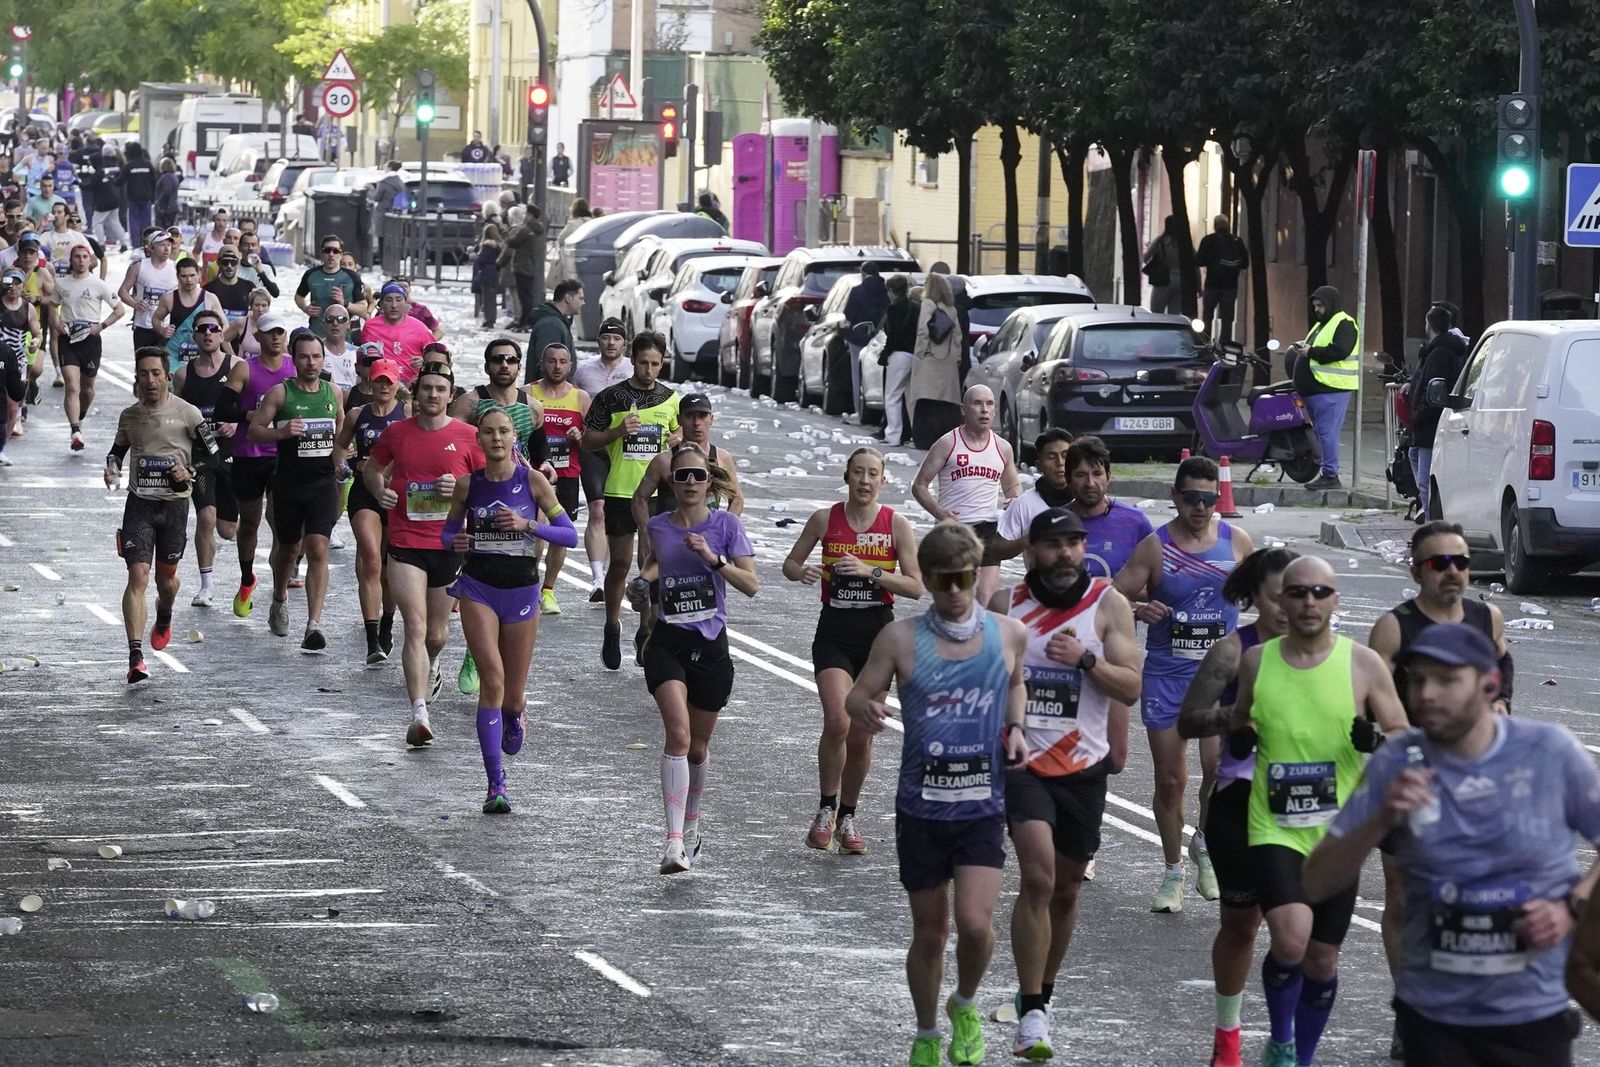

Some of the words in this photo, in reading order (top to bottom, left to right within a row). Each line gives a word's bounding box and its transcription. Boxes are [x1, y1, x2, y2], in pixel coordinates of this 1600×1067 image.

[330, 94, 350, 105] 30
[1122, 418, 1148, 429] 4249
[1151, 418, 1172, 429] GBR
[1275, 414, 1294, 422] cabify
[310, 423, 331, 433] ZURICH
[298, 441, 316, 450] JOSE
[317, 440, 334, 449] SILVA
[627, 443, 658, 452] MORENO
[474, 532, 524, 541] BERNADETTE
[856, 533, 892, 548] SOPH
[828, 543, 889, 557] SERPENTINE
[677, 575, 708, 585] ZURICH
[680, 590, 697, 599] 5263
[837, 589, 873, 600] SOPHIE
[673, 599, 706, 613] YENTL
[1191, 612, 1222, 621] ZURICH
[1171, 638, 1202, 649] MTNEZ
[1034, 670, 1075, 682] ZURICH
[1025, 700, 1064, 716] TIAGO
[947, 743, 985, 755] ZURICH
[1288, 764, 1329, 776] ZURICH
[922, 773, 992, 789] ALEXANDRE
